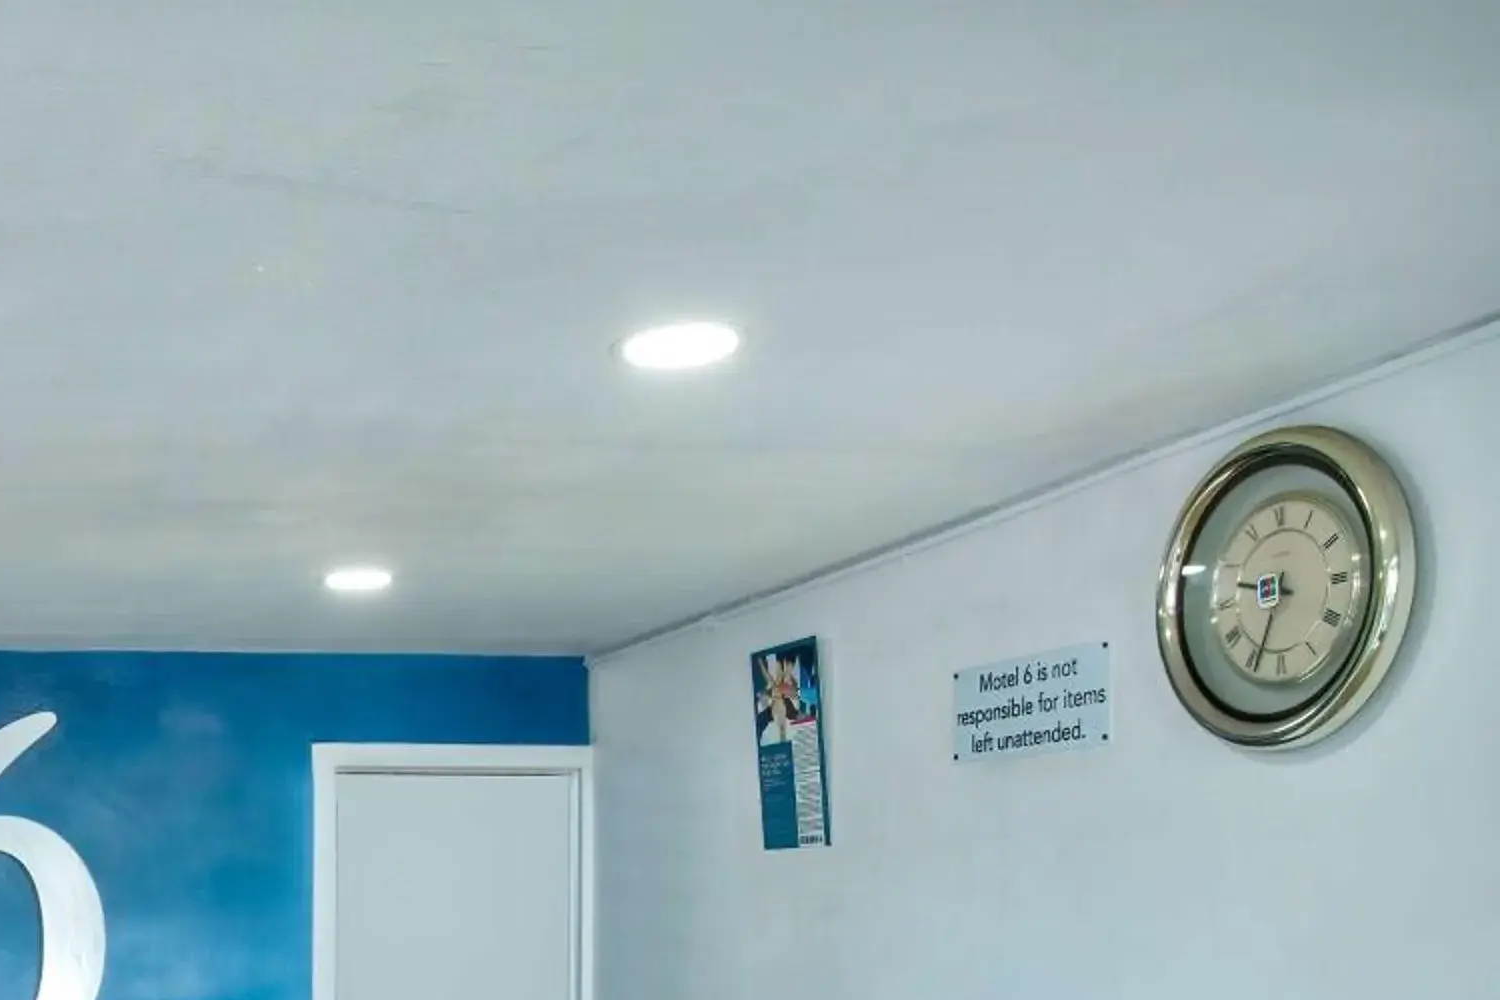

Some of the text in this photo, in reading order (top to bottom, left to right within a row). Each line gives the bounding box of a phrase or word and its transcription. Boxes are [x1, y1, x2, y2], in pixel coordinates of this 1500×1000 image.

[979, 658, 1078, 693] Motel 6 is not
[956, 688, 1107, 728] responsible for items
[971, 718, 1087, 753] left unattended.
